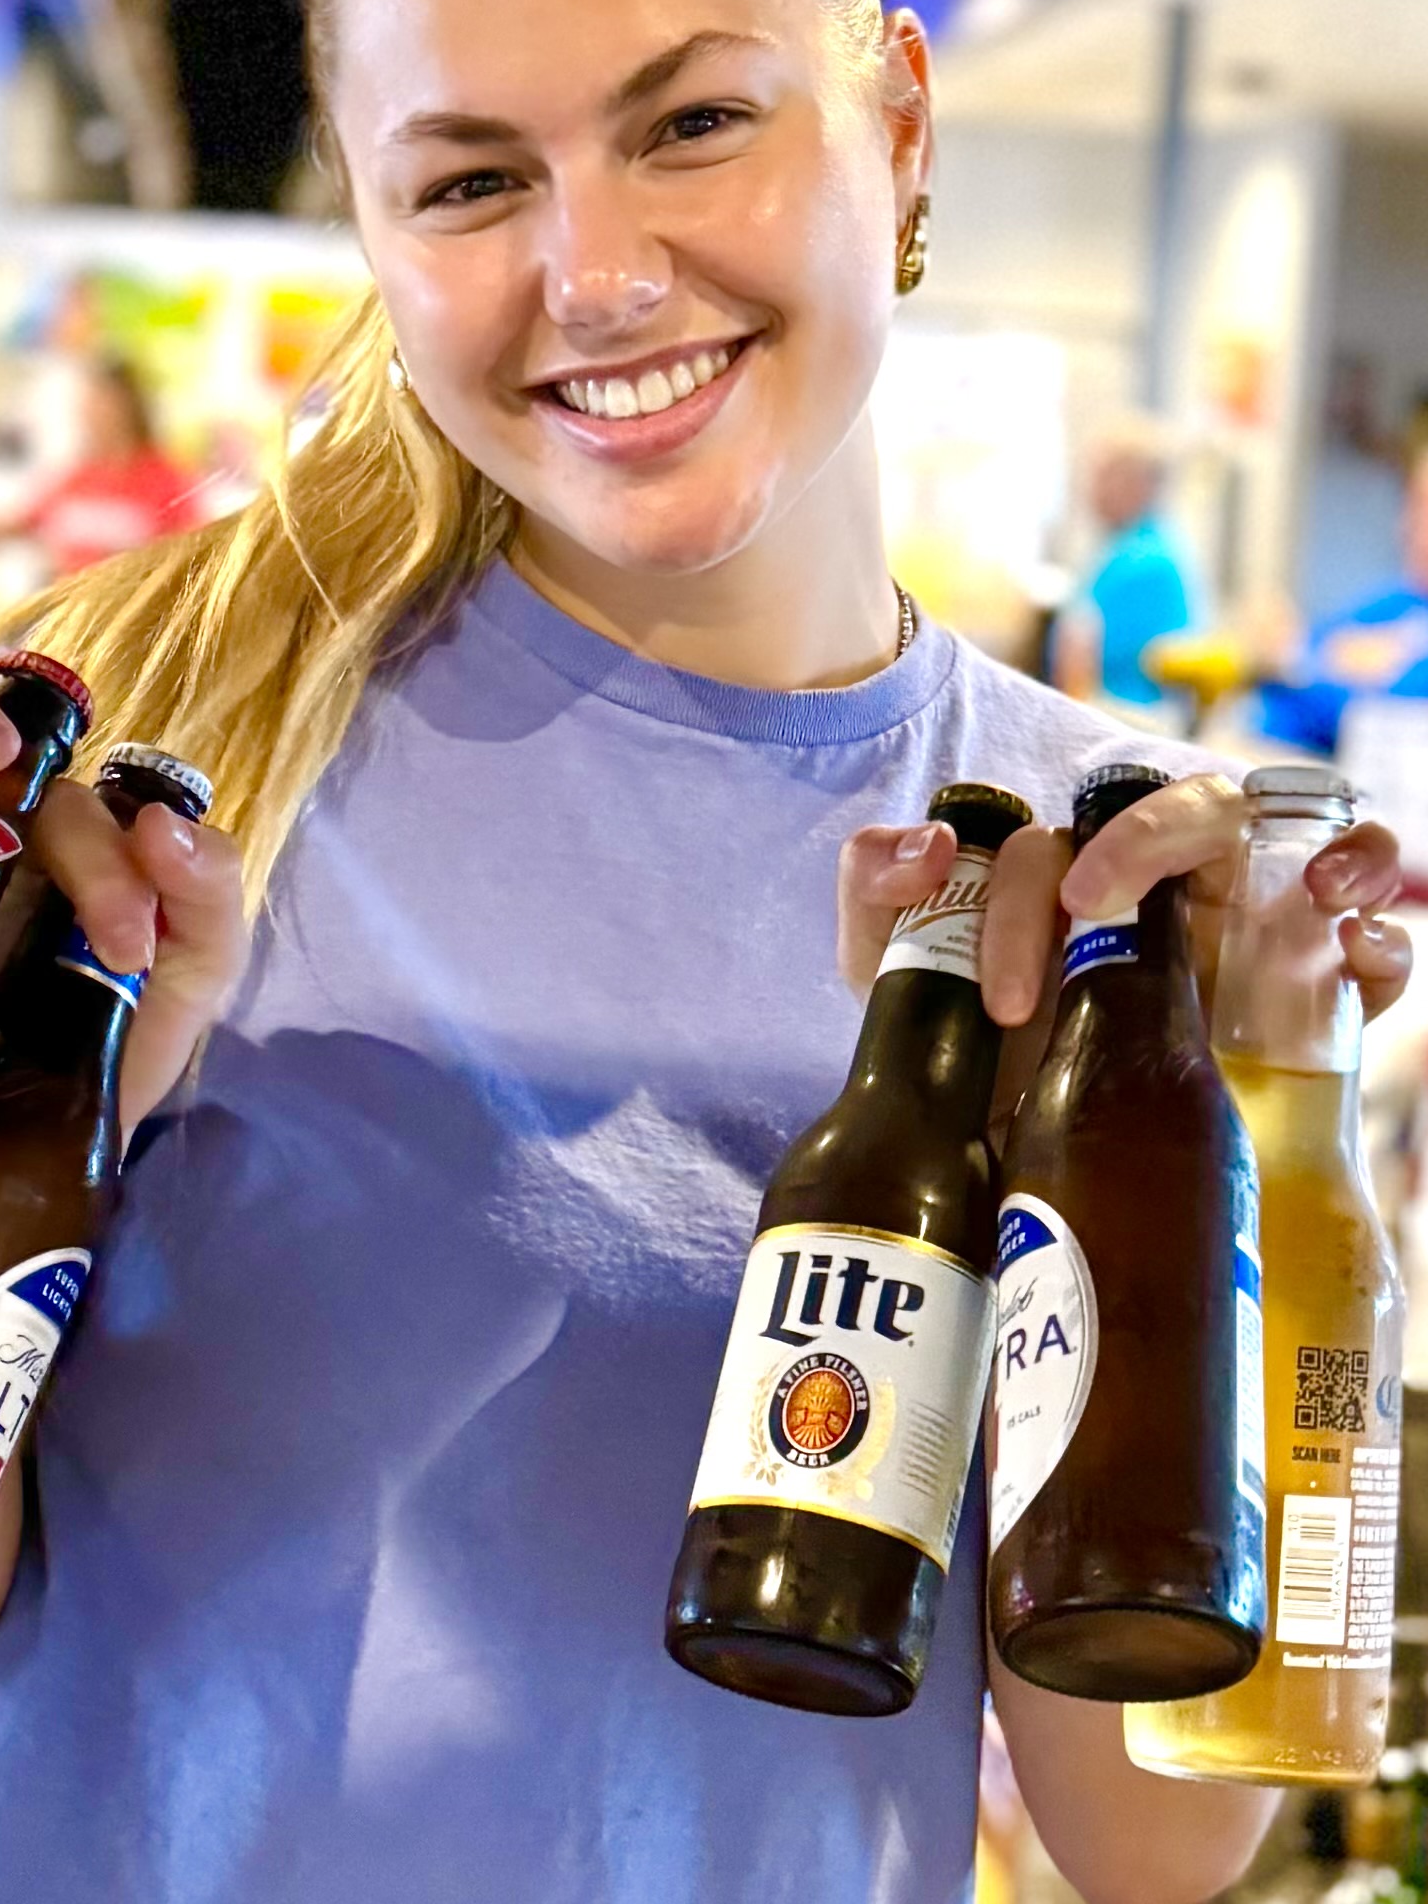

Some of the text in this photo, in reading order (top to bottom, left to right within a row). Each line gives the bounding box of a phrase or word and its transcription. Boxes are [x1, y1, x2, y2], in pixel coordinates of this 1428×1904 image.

[899, 881, 990, 926] Mill
[759, 1251, 925, 1347] Lite
[777, 1355, 868, 1411] A FINE PILSNER
[786, 1449, 831, 1466] BEER
[1292, 1446, 1341, 1463] SCAN HERE
